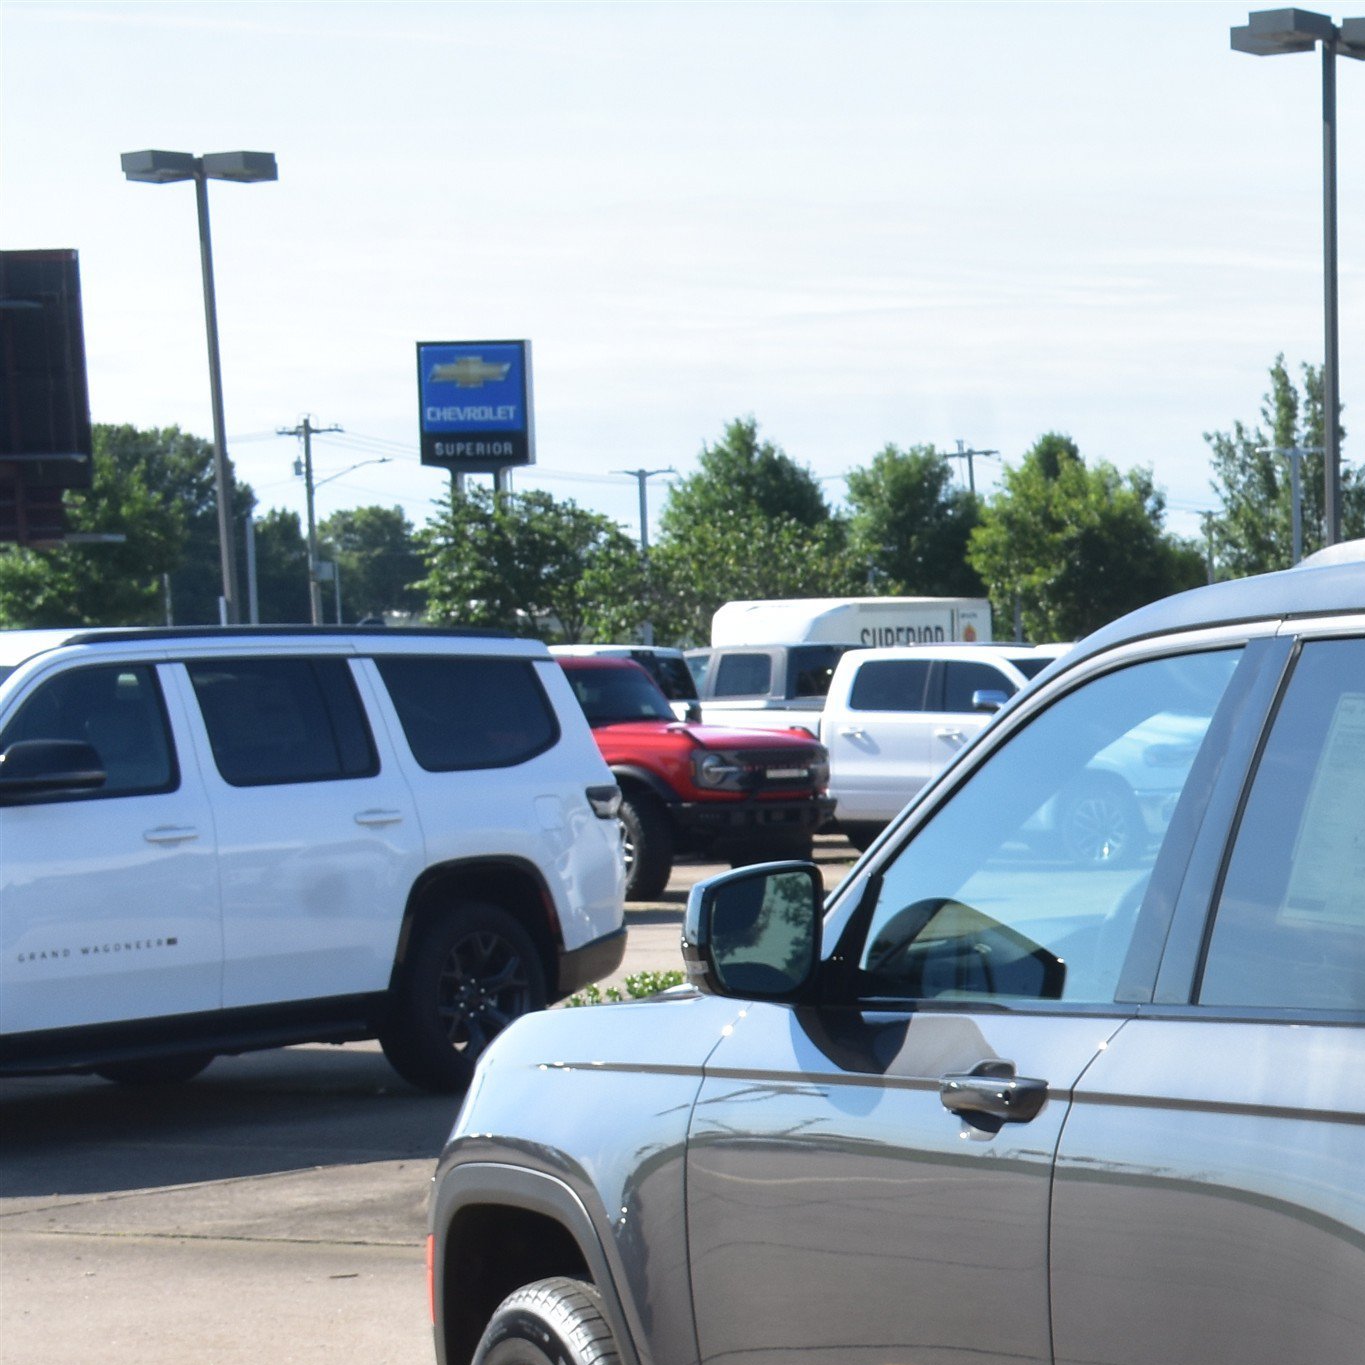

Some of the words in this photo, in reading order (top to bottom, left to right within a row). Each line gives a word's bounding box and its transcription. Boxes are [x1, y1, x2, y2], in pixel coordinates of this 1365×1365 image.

[426, 405, 517, 421] CHEVROLET
[434, 442, 513, 456] SUPERIOR
[17, 949, 71, 962] GRAND
